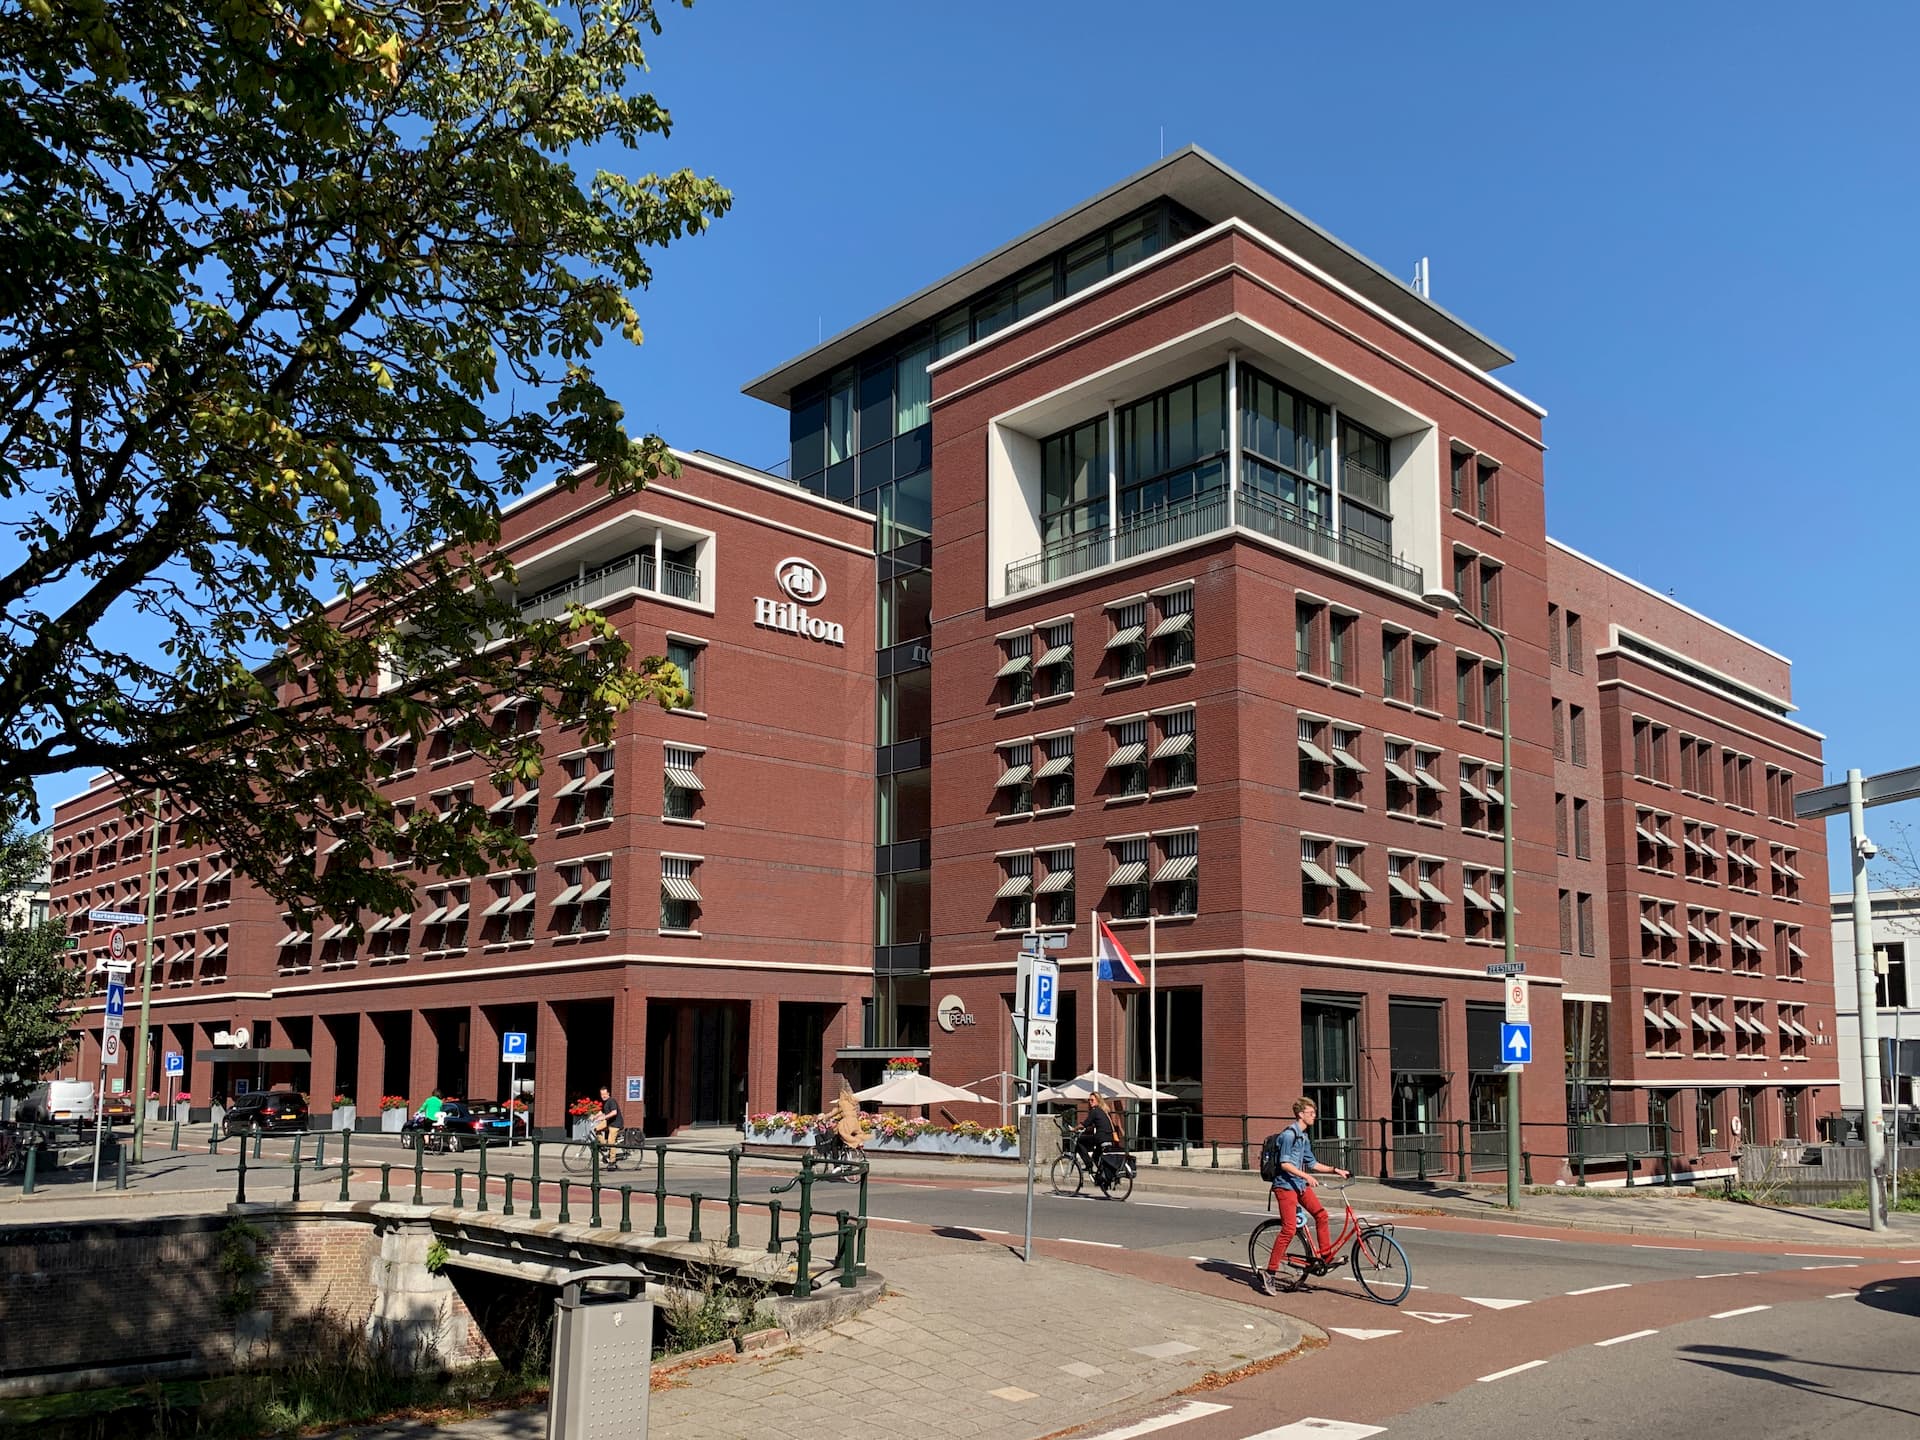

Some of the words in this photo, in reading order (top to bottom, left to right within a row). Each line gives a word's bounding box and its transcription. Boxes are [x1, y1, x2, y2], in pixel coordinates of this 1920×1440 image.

[753, 596, 845, 644] Hilton
[1041, 978, 1050, 999] P
[950, 1013, 976, 1025] PEARL
[508, 1035, 521, 1052] P
[170, 1058, 180, 1069] P
